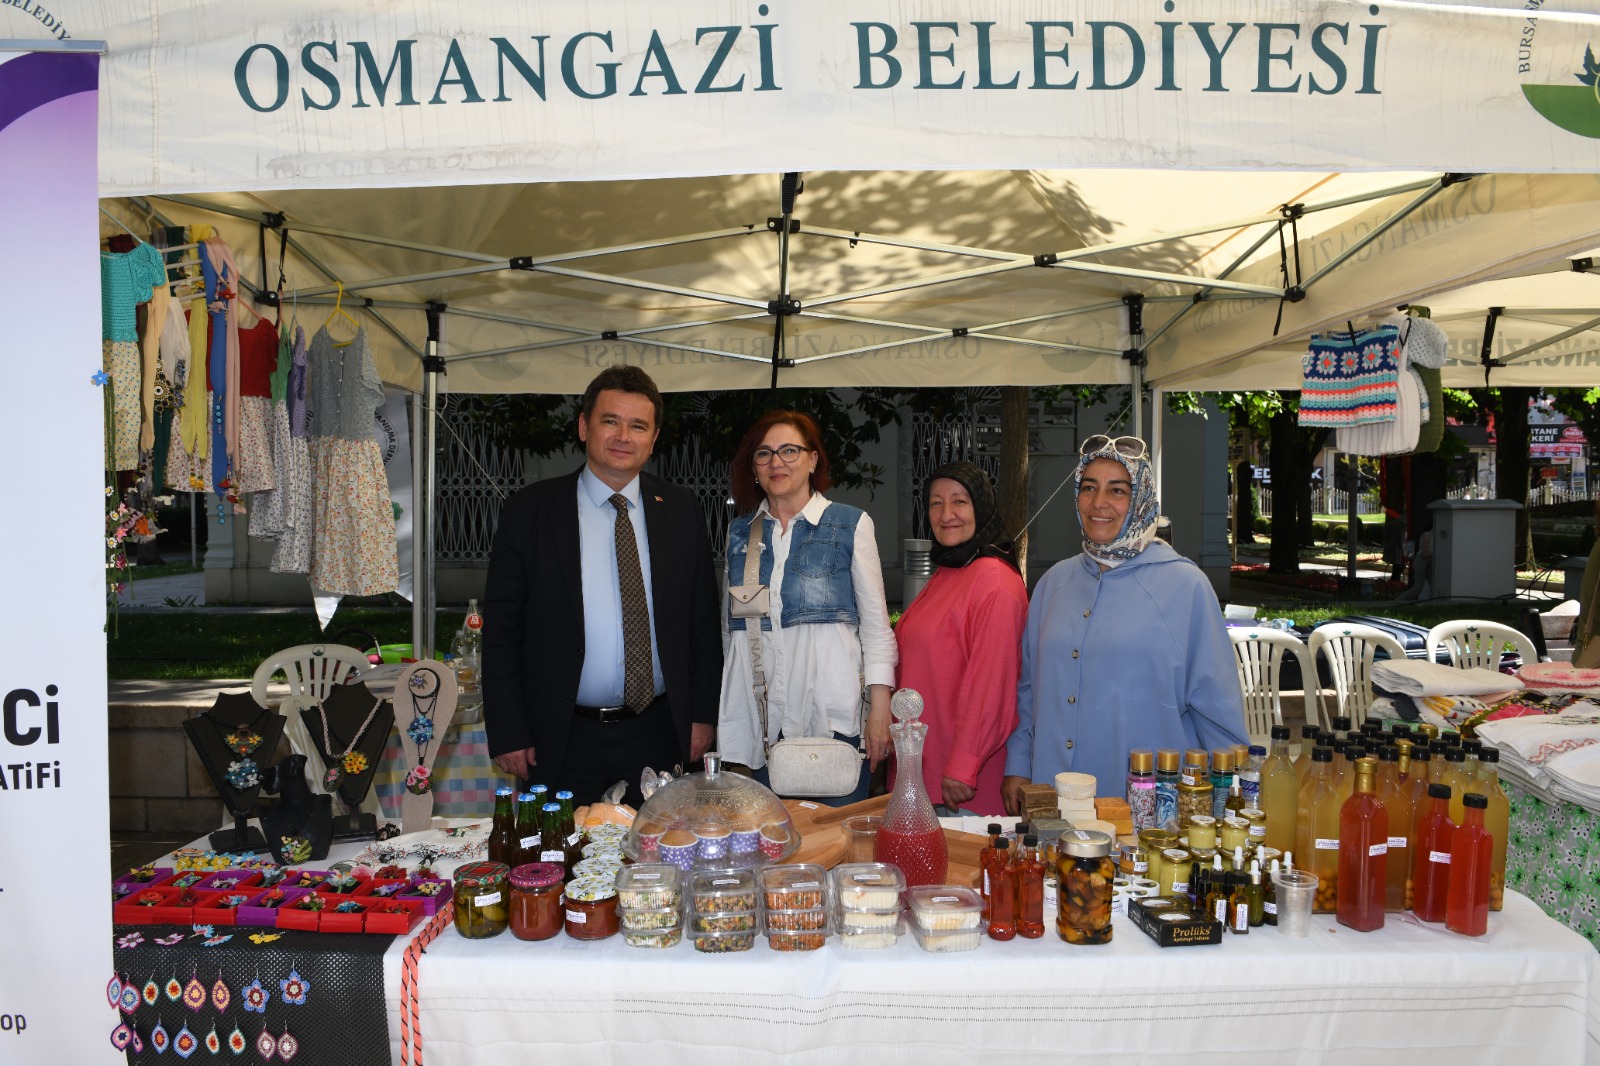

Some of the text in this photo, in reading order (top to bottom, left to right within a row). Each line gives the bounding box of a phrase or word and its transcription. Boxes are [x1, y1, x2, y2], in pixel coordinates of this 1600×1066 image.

[233, 0, 1387, 114] OSMANGAZİ BELEDİYESİ
[1518, 16, 1539, 75] BURSA
[0, 1014, 27, 1035] op
